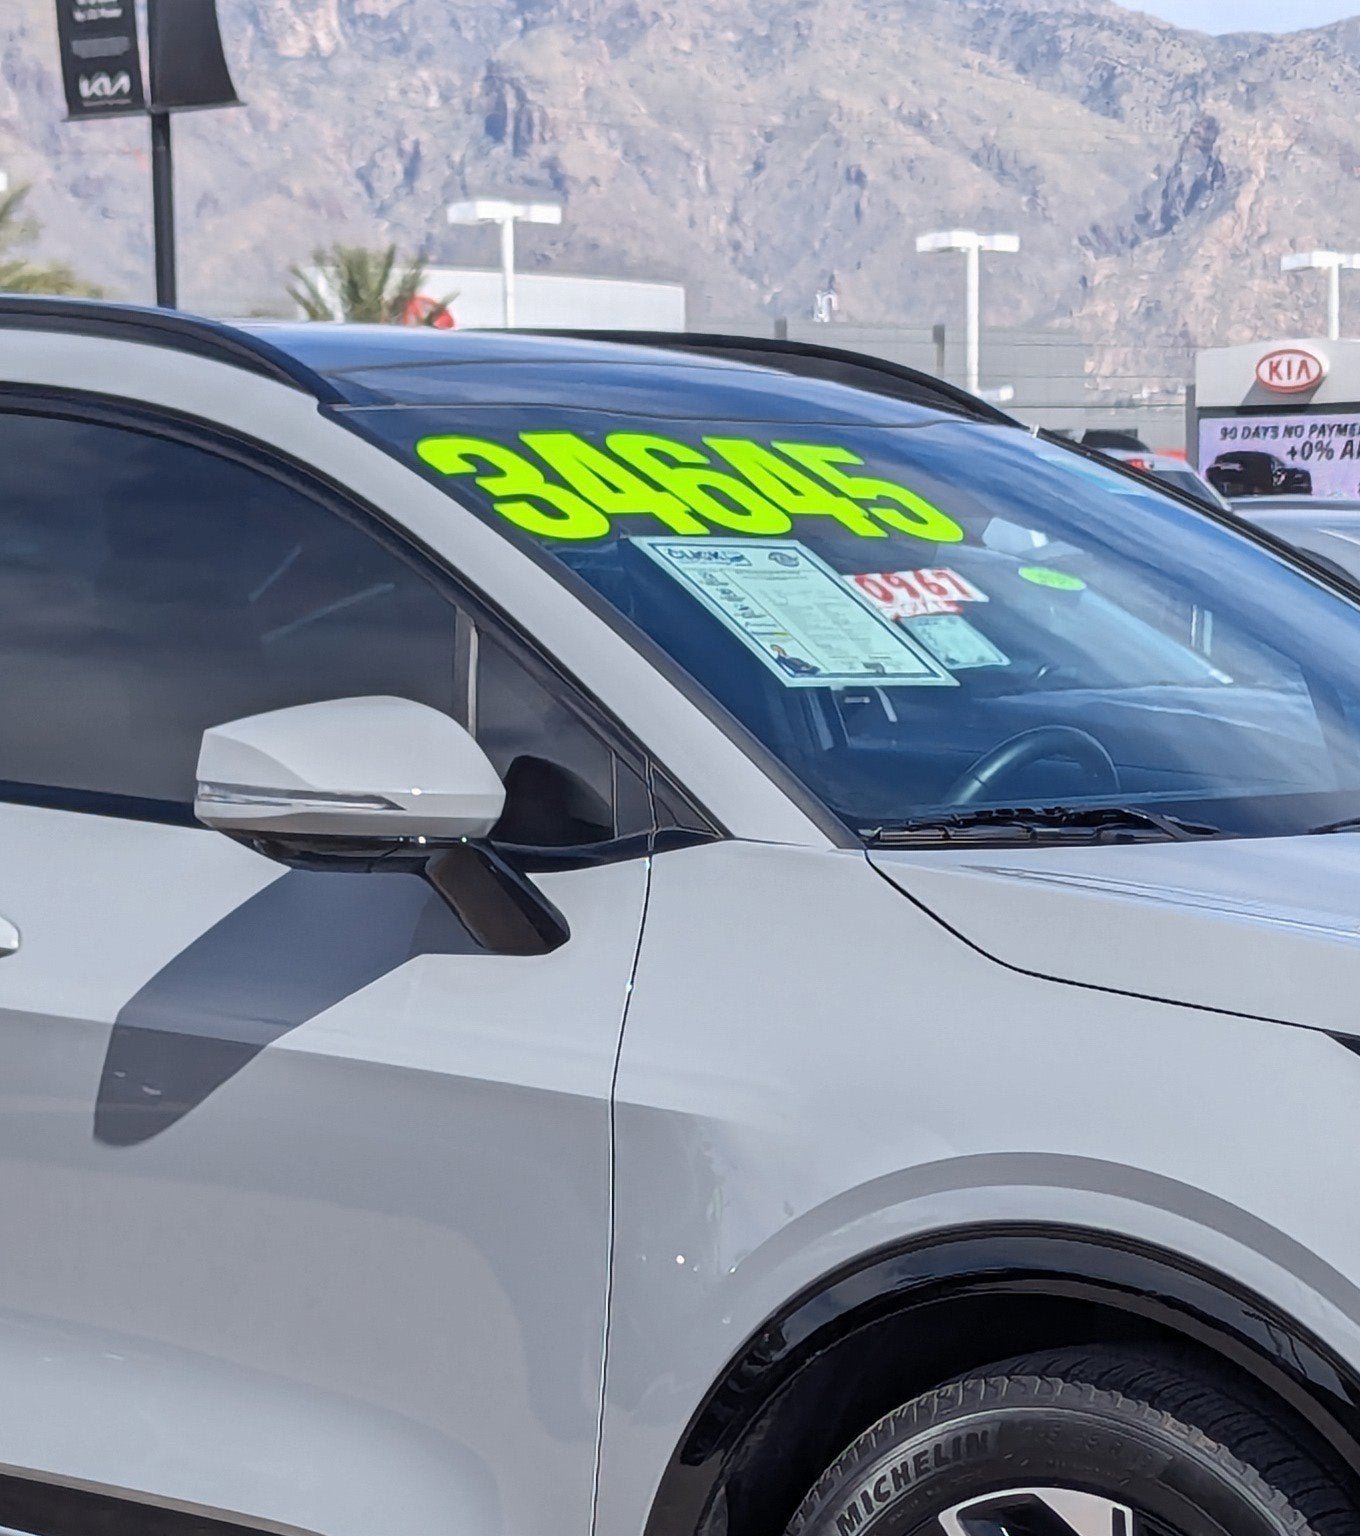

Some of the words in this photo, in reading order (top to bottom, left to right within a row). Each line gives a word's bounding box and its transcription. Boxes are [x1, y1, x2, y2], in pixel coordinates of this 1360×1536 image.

[1268, 359, 1311, 381] KIA
[1241, 425, 1279, 440] DAYS
[1282, 424, 1305, 439] NO
[1286, 440, 1335, 462] +0%
[416, 430, 964, 543] 34645
